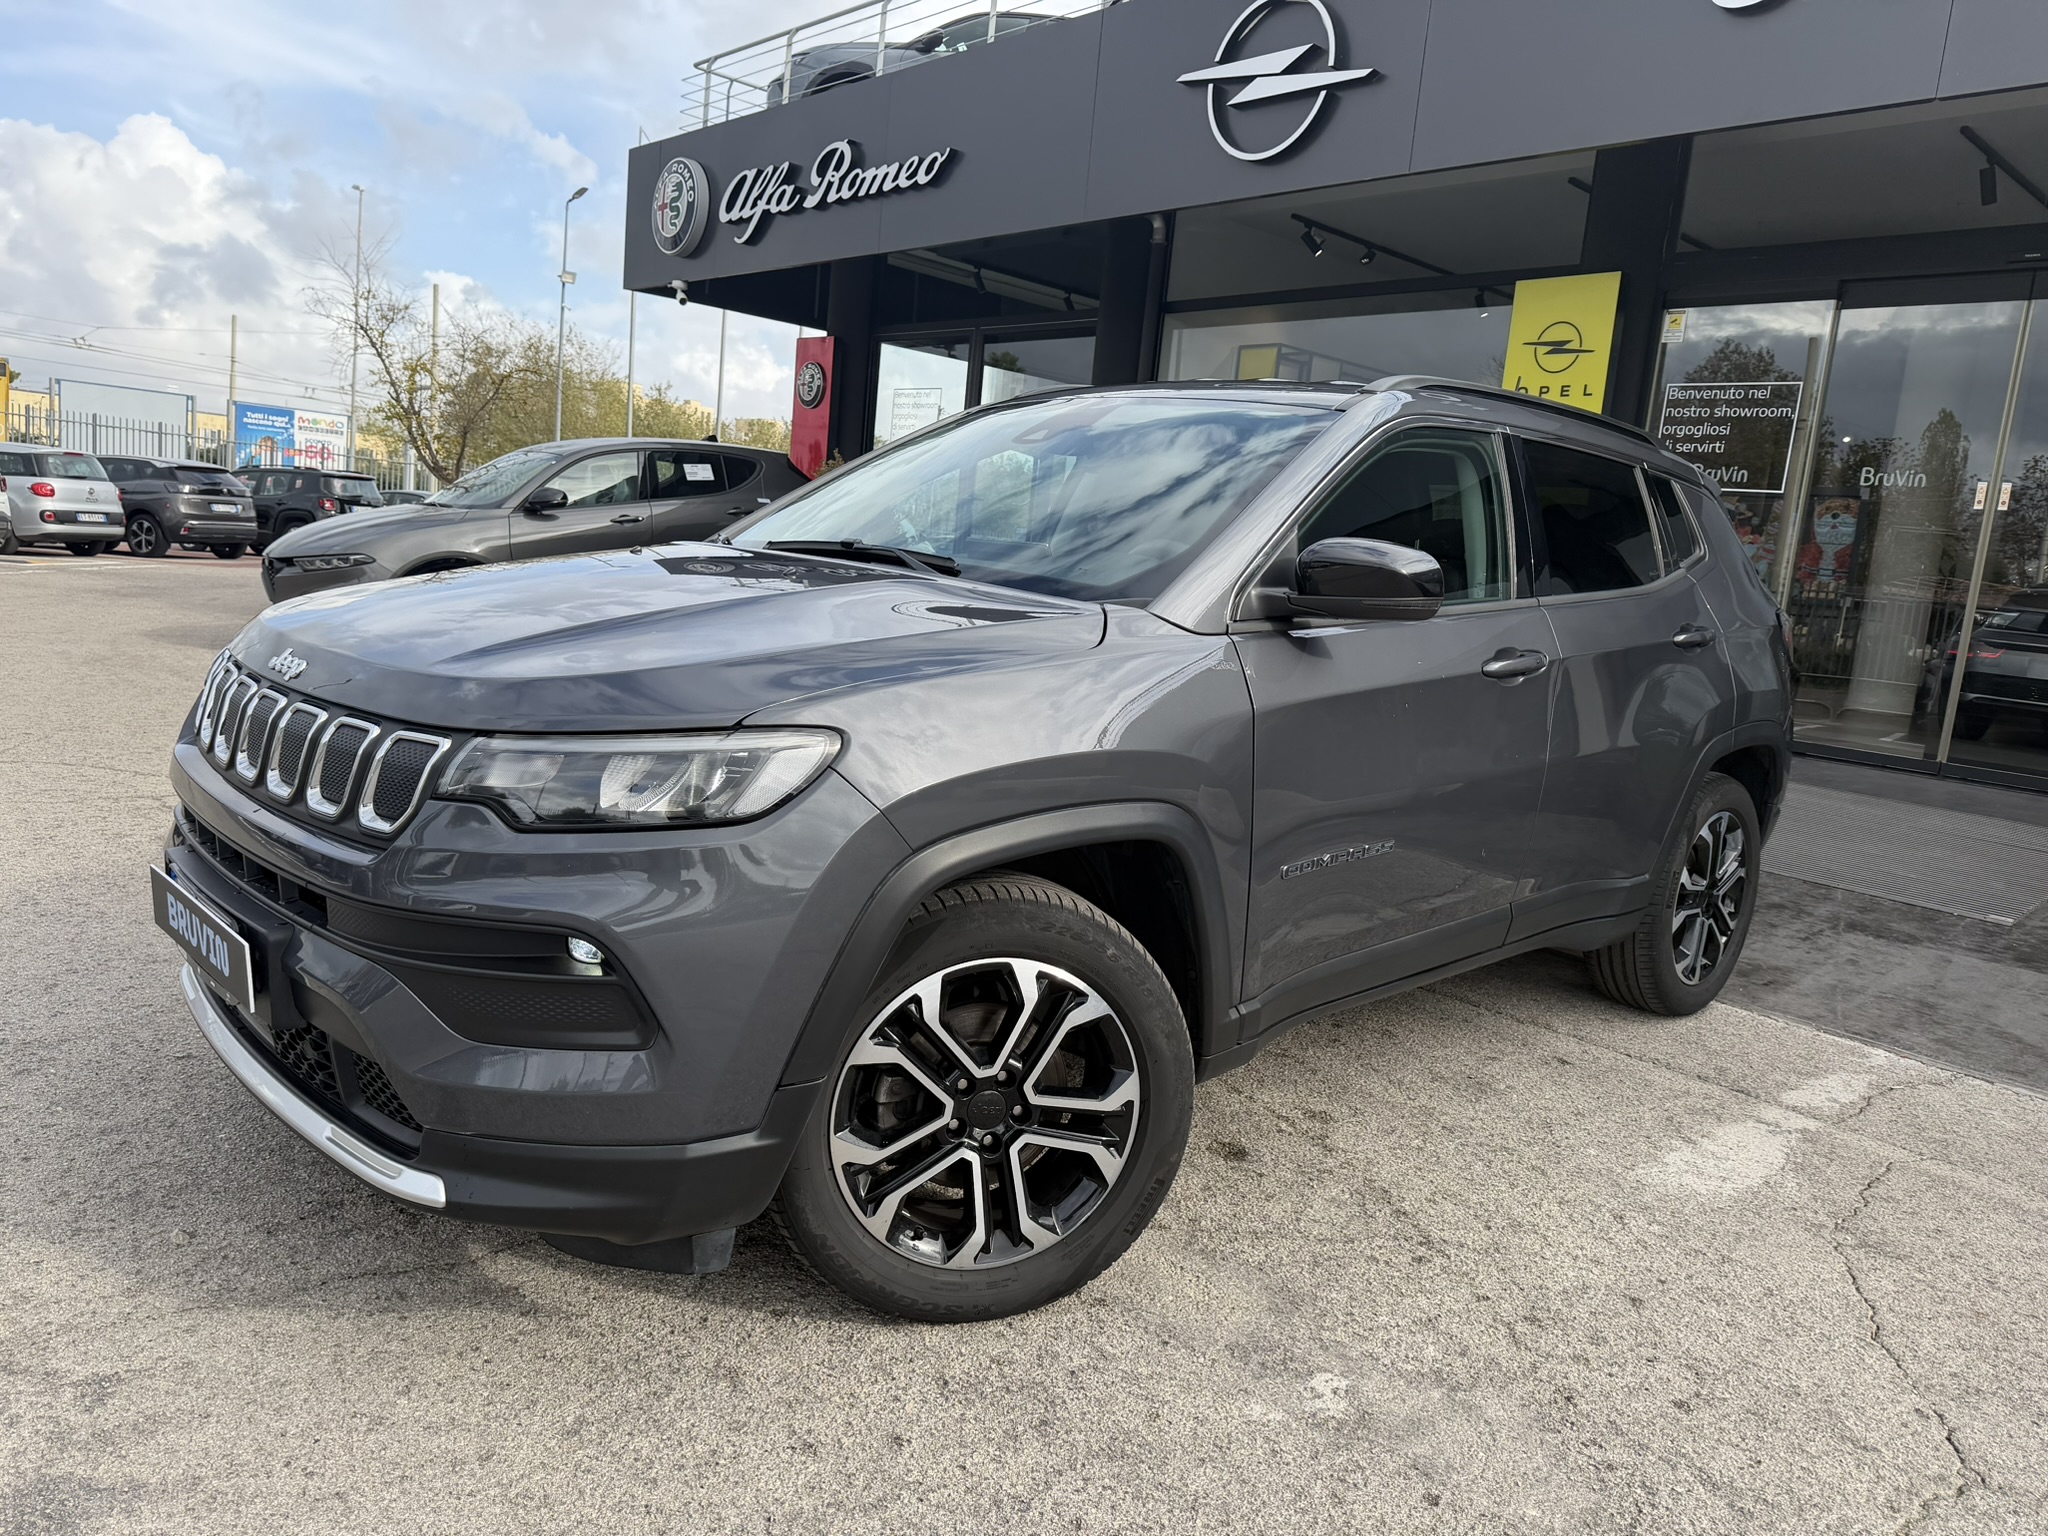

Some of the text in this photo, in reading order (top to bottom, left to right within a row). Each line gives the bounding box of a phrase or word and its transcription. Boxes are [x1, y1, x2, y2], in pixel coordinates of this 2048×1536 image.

[672, 163, 694, 202] ROMEO
[718, 138, 950, 244] Alfa Romeo
[1668, 386, 1771, 400] Benvenuto nel
[1665, 404, 1795, 420] nostro showroom,
[1662, 422, 1731, 438] orgogliosi
[1676, 440, 1726, 453] servirti
[1859, 466, 1927, 488] BruVin
[268, 647, 308, 681] Jeep
[1280, 840, 1395, 880] COMPASS
[166, 891, 230, 978] BRUVIN
